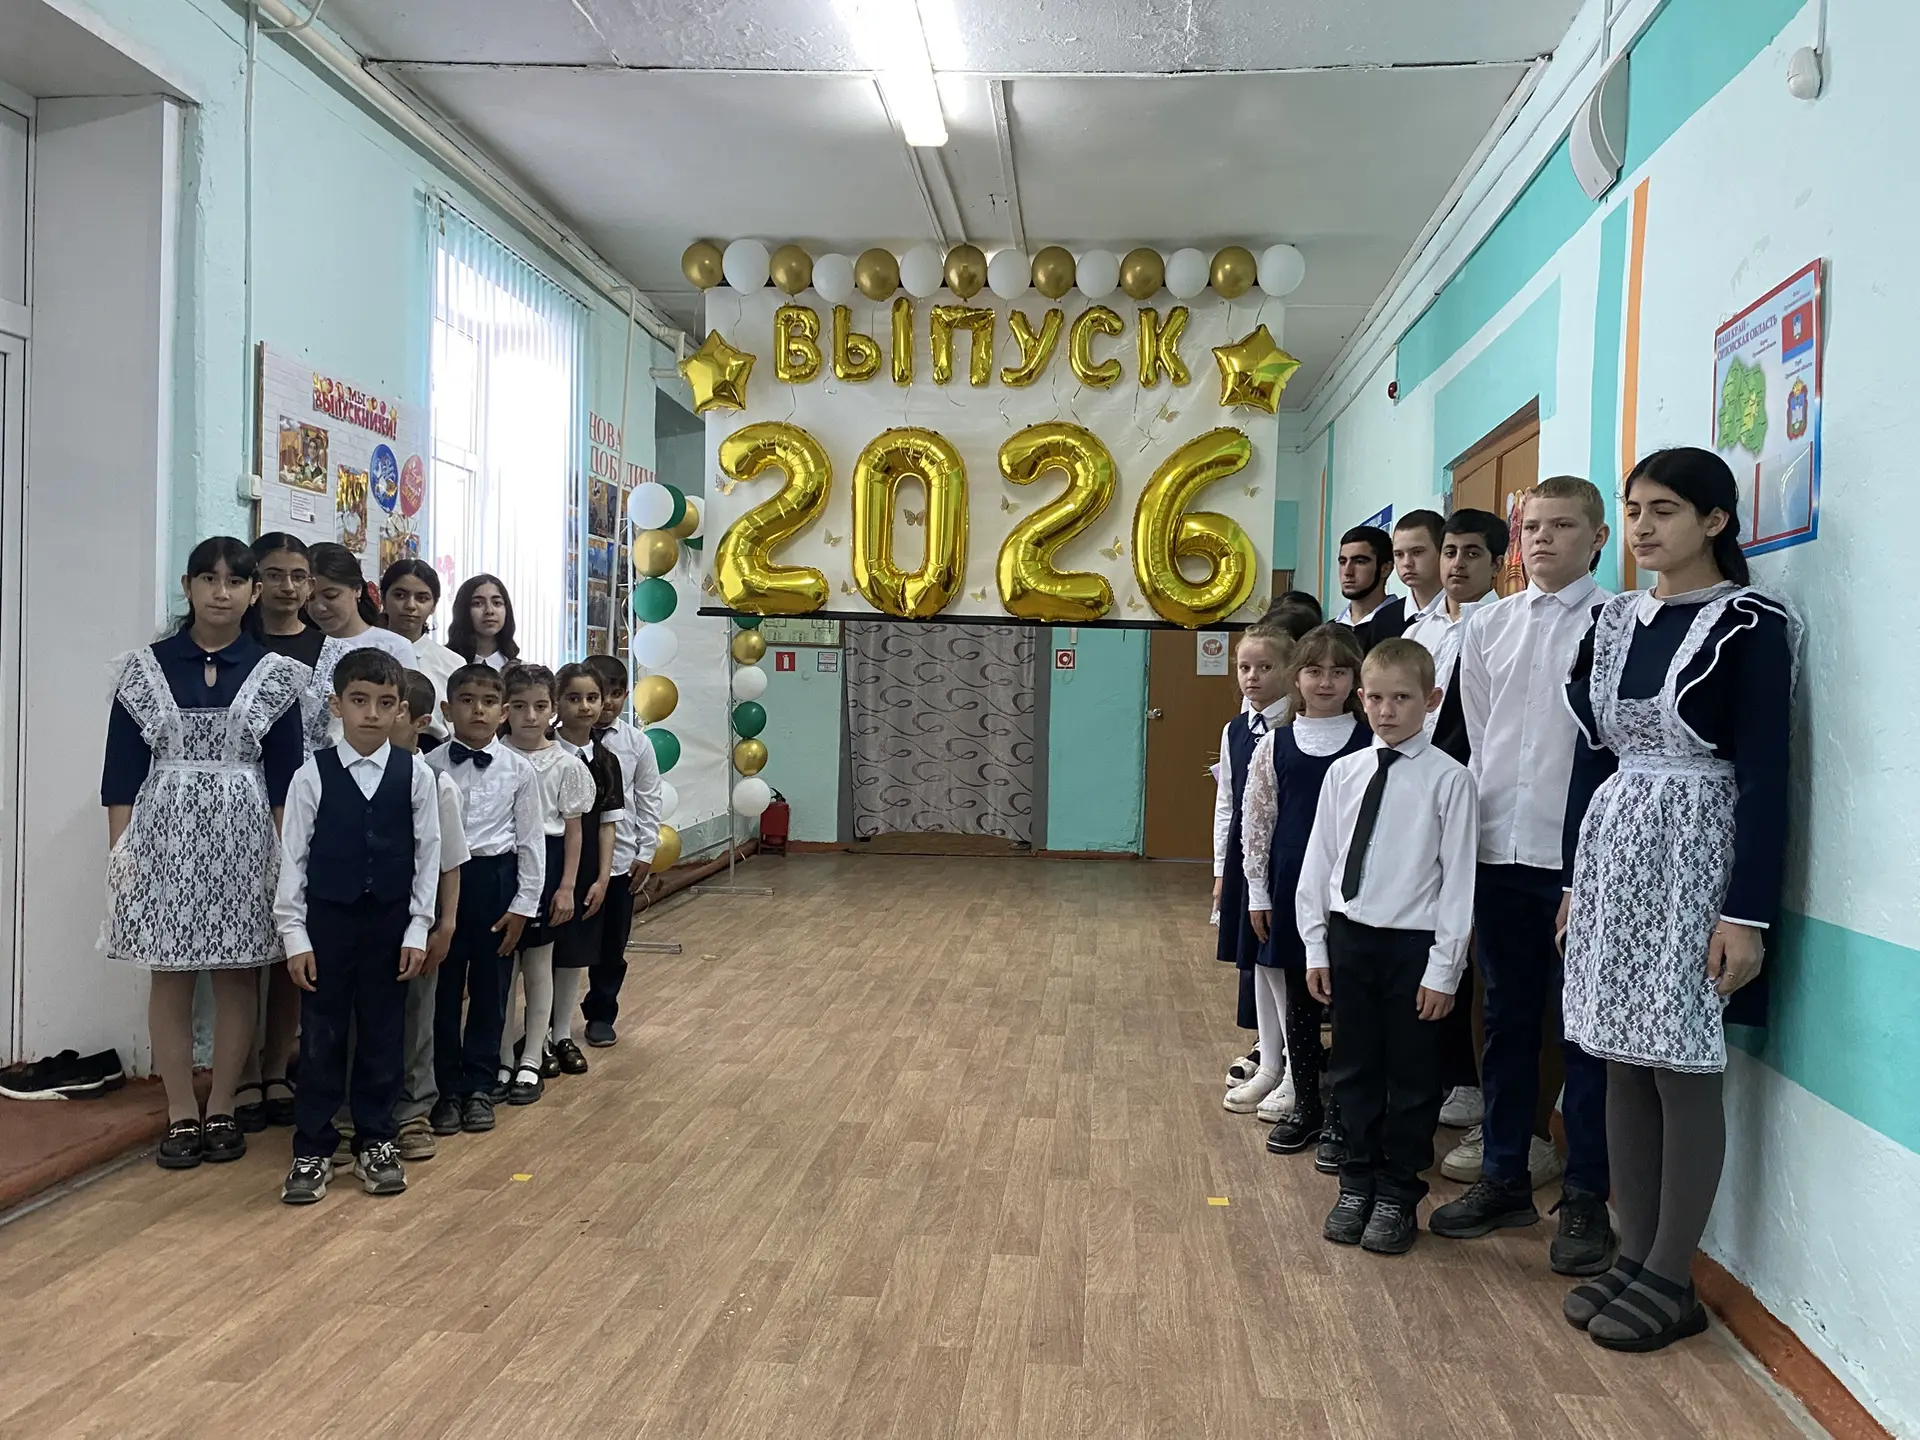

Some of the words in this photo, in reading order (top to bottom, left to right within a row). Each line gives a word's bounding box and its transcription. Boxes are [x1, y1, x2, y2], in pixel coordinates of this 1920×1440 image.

[773, 296, 1191, 389] ВЫПУСК
[313, 387, 397, 441] ВЫПУСКНИКИ!
[589, 445, 655, 488] ПОБДИ
[714, 420, 1258, 629] 2026
